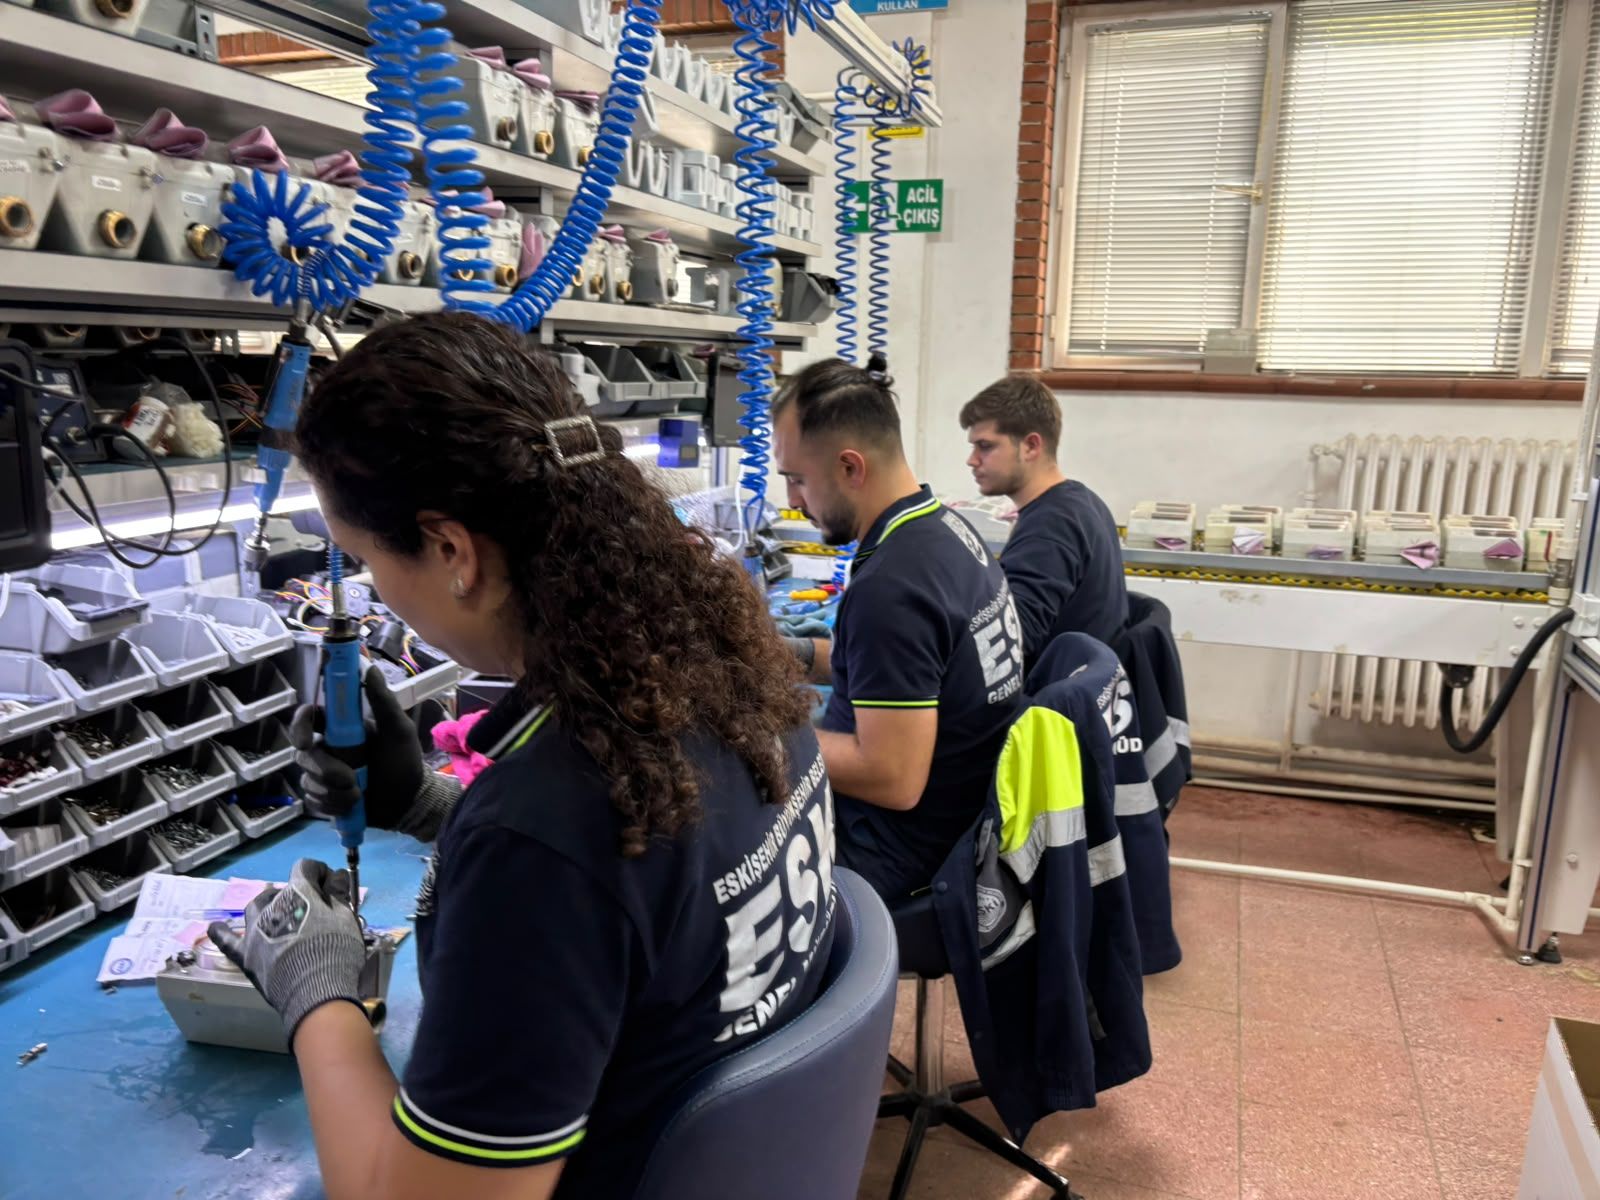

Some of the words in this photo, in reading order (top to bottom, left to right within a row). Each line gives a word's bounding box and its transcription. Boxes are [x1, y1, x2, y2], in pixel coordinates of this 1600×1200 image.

[876, 0, 919, 11] KULLAN
[906, 183, 938, 203] ACİL
[903, 207, 940, 228] ÇIKIŞ
[1112, 735, 1143, 755] ÜD
[713, 830, 778, 904] ESKİŞEHİR
